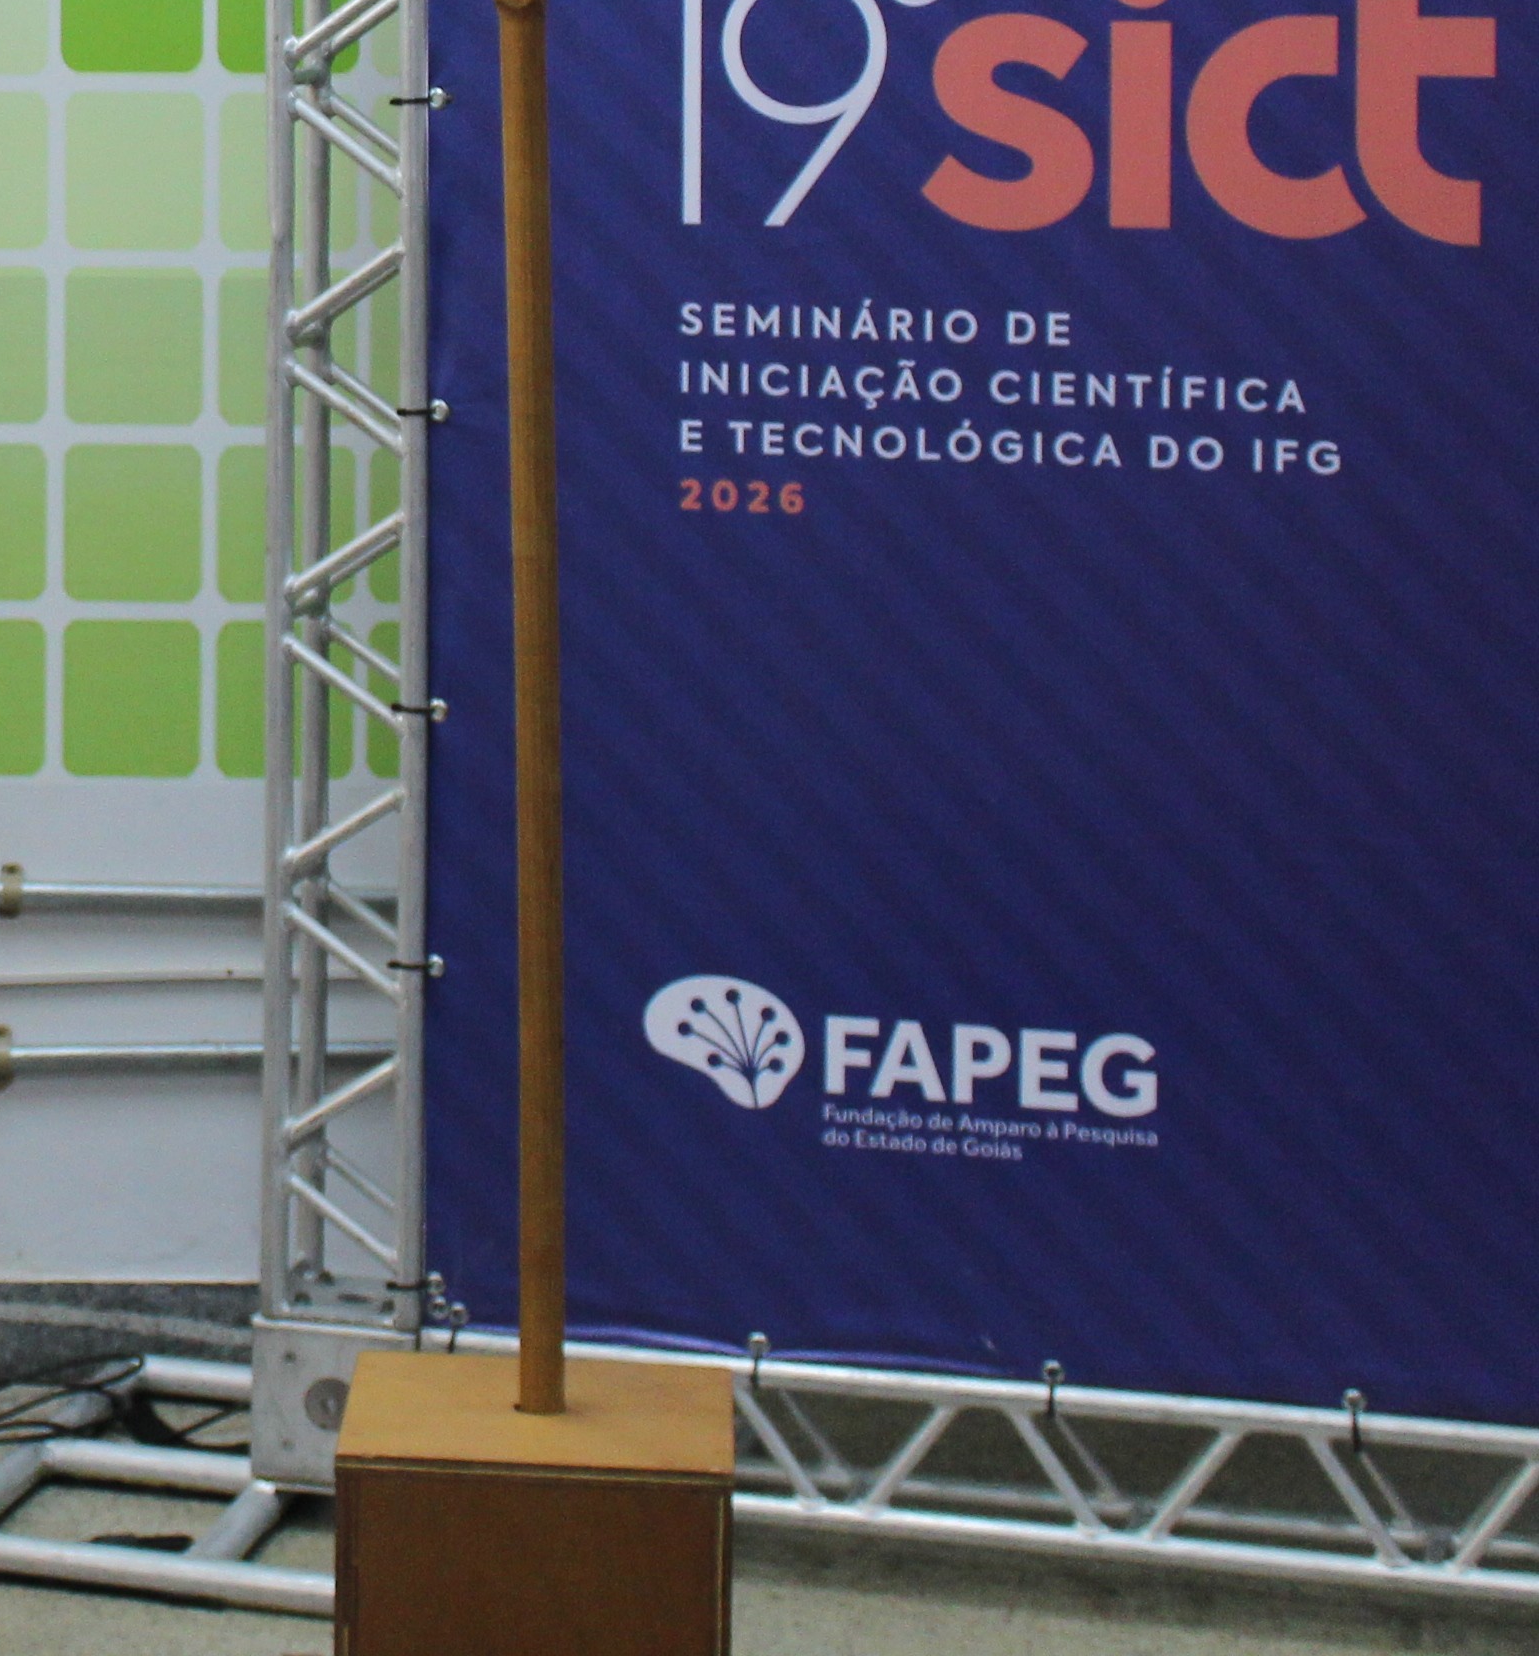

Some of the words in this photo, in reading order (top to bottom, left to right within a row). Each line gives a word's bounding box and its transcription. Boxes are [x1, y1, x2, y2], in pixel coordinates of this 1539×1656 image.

[679, 297, 979, 344] SEMINÁRIO
[1005, 310, 1071, 347] DE
[680, 358, 963, 410] INICIAÇÃO
[989, 365, 1305, 413] CIENTÍFICA
[679, 418, 703, 453] E
[727, 418, 1122, 467] TECNOLÓGICA
[1149, 434, 1224, 471] DO
[1252, 438, 1341, 475] IFG
[680, 477, 805, 515] 2026
[824, 1014, 1158, 1117] FAPEG
[822, 1104, 922, 1132] Fundação
[929, 1111, 954, 1130] de
[959, 1113, 1041, 1140] Amparo
[1064, 1121, 1159, 1147] Pesquisa
[822, 1128, 850, 1146] do
[855, 1129, 927, 1152] Estado
[931, 1136, 958, 1155] de
[963, 1137, 1024, 1161] Goiás
